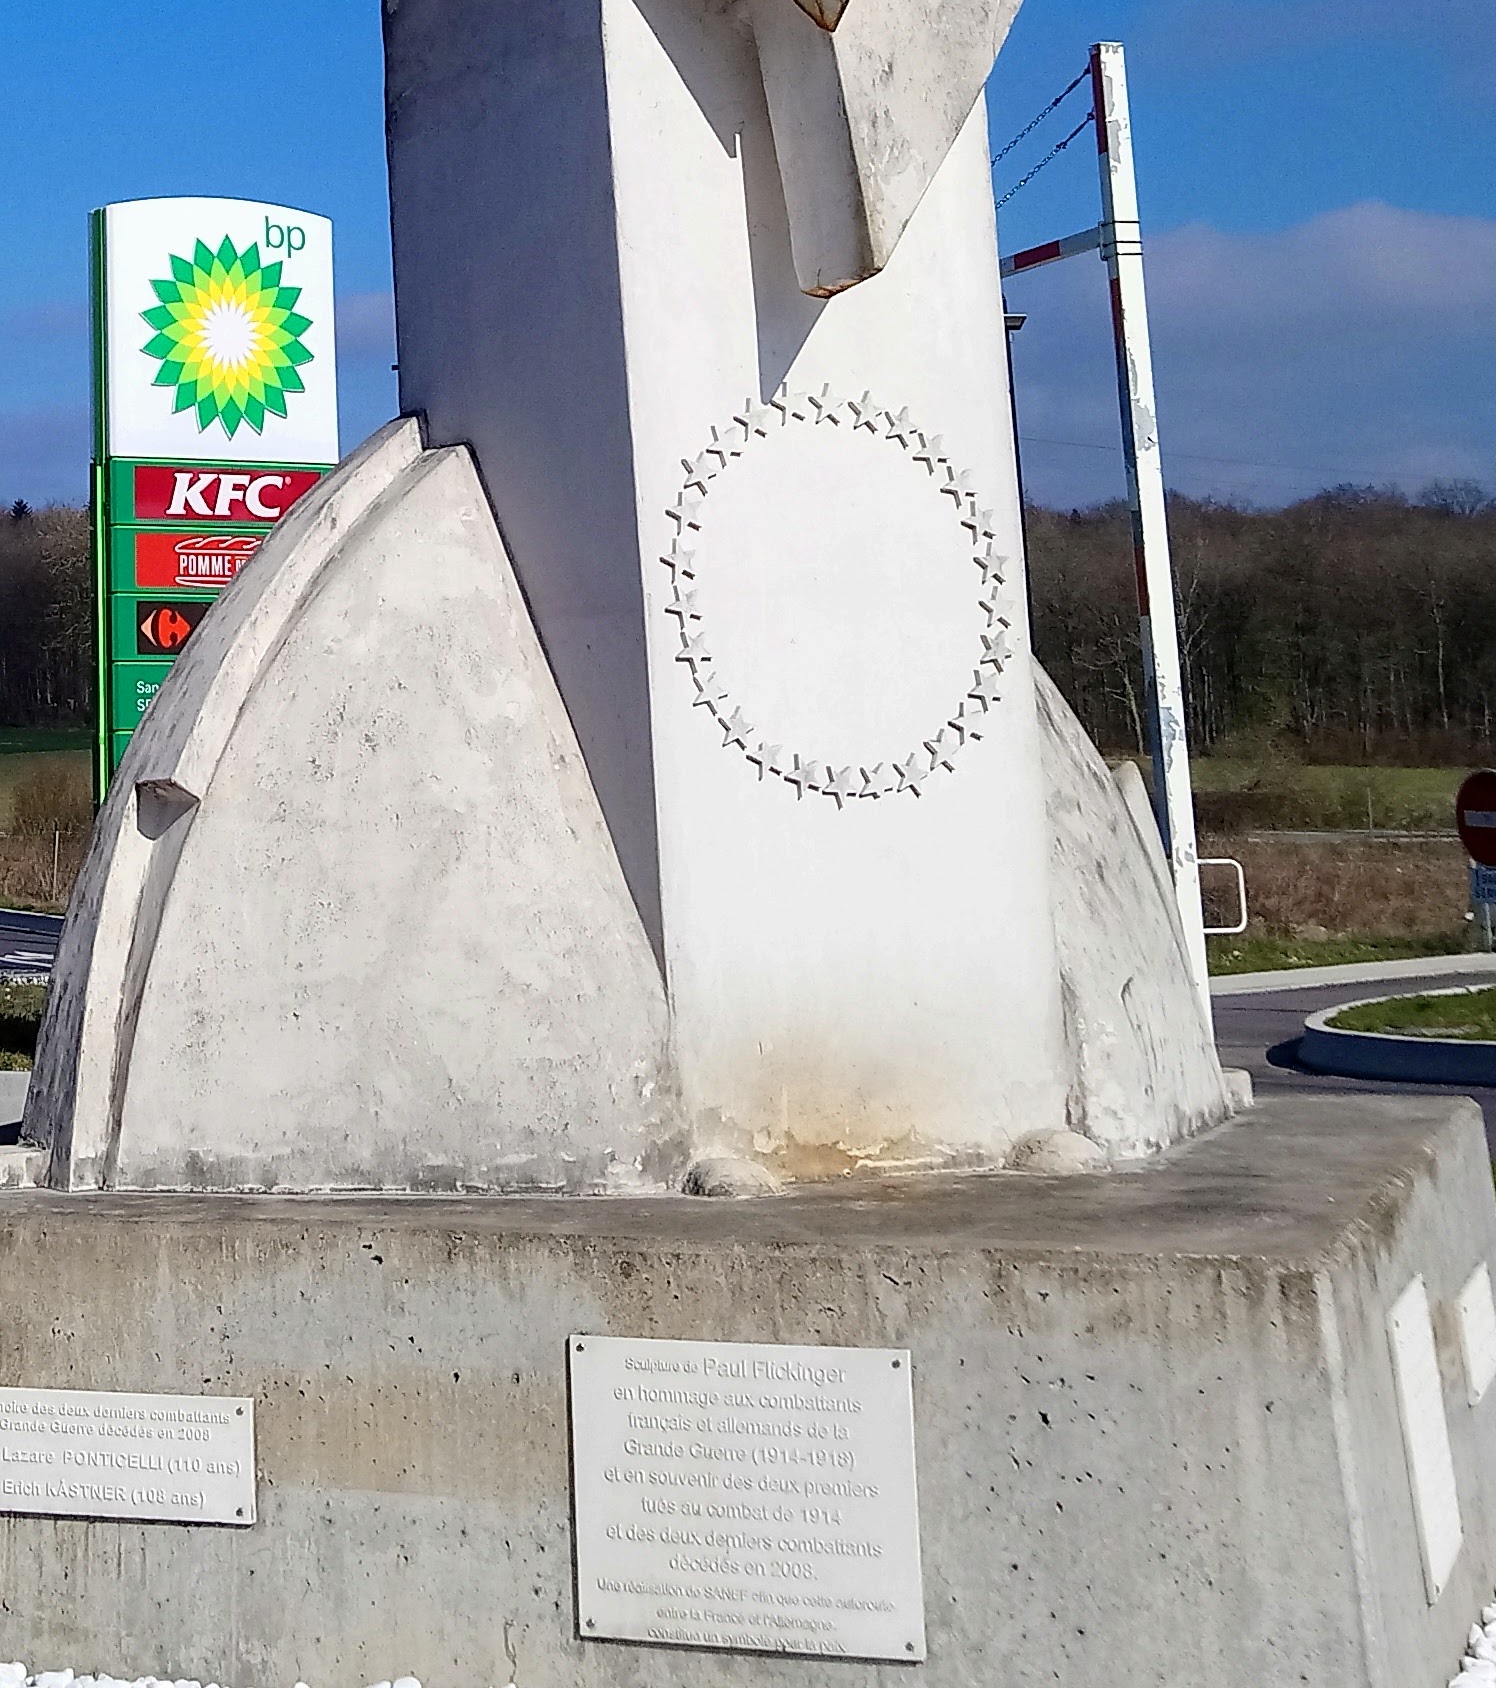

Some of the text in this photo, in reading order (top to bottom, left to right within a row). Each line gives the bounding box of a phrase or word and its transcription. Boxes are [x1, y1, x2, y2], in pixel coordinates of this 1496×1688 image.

[265, 216, 306, 258] bp
[166, 472, 284, 518] KFC
[180, 554, 232, 576] POMME
[624, 1357, 846, 1387] Sculpture de Paul Flickinger
[31, 1402, 55, 1415] des
[59, 1403, 90, 1416] deux
[94, 1405, 146, 1419] derniers
[150, 1409, 230, 1424] combattants
[613, 1384, 863, 1413] en hommage aux combattants
[0, 1418, 46, 1432] Grande
[50, 1420, 94, 1435] Guerre
[158, 1428, 173, 1439] en
[178, 1427, 211, 1441] 2008
[627, 1412, 849, 1440] français et allemands de la
[2, 1448, 56, 1463] Lazare
[63, 1449, 163, 1471] PONTICELLI
[167, 1457, 202, 1474] (110
[206, 1460, 241, 1477] ans)
[624, 1438, 857, 1472] Grande Guerre (1914-1918)
[2, 1479, 42, 1496] Erich
[171, 1491, 206, 1509] ans)
[603, 1466, 880, 1498] et en souvenir des deux premiers
[681, 1501, 703, 1516] au
[707, 1503, 769, 1521] combat
[772, 1505, 795, 1522] de
[802, 1506, 843, 1525] 1914
[606, 1523, 883, 1558] et des deux derniers combattants
[744, 1562, 766, 1576] en
